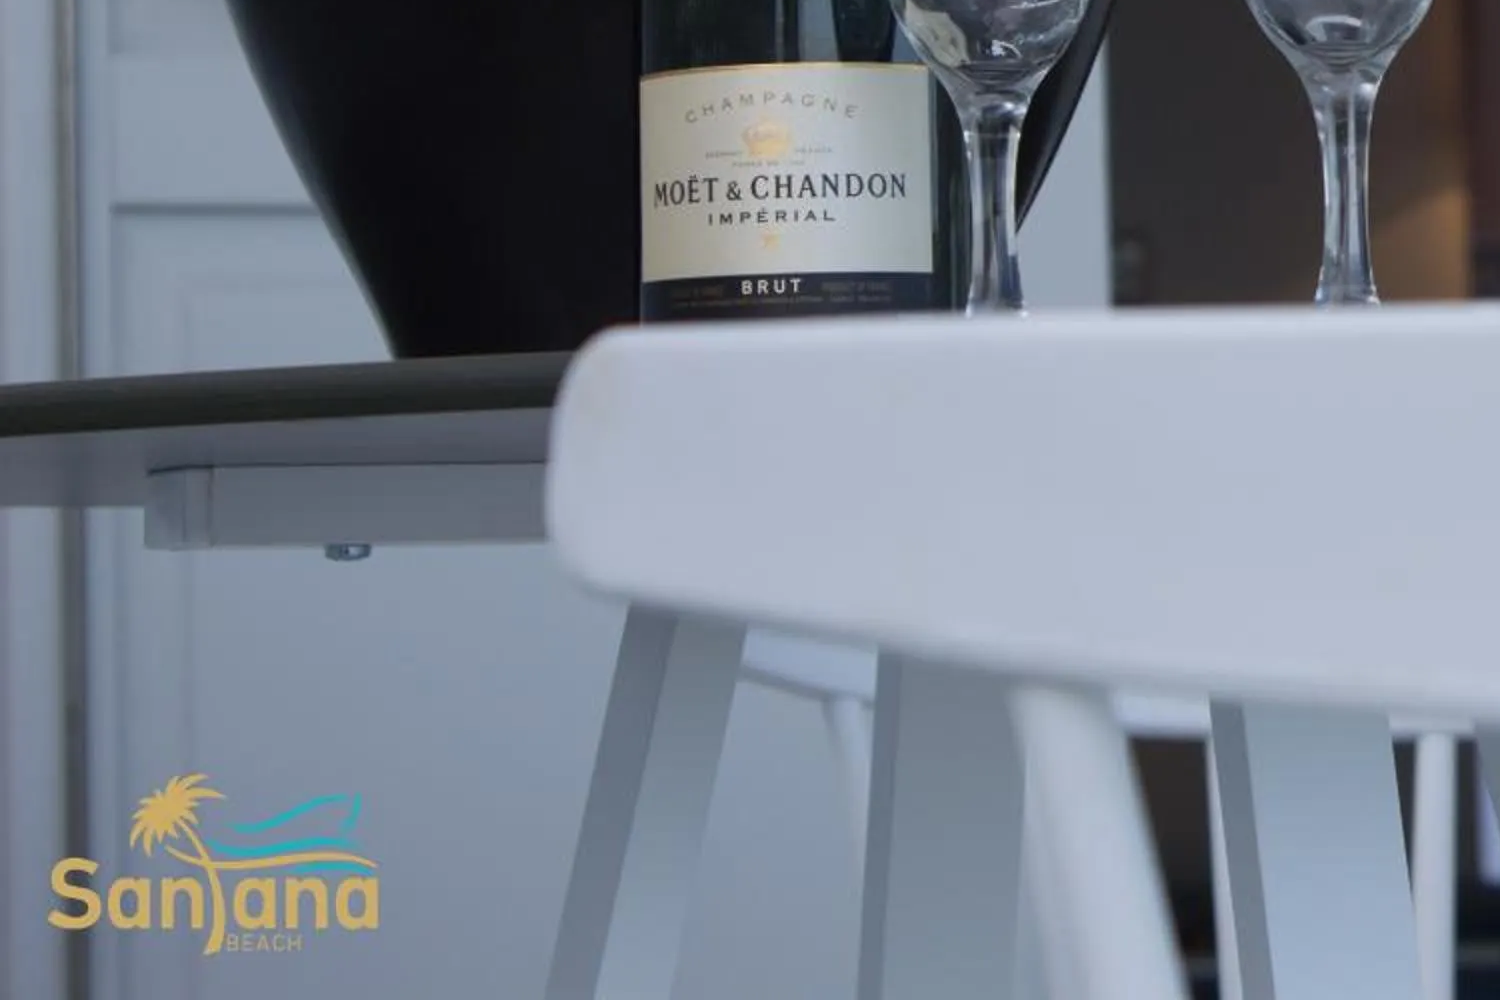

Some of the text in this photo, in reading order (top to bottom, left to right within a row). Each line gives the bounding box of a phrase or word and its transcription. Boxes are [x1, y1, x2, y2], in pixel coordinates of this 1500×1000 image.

[685, 91, 860, 123] CHAMPAGNE
[654, 173, 907, 208] MOËT & CHANDON
[708, 208, 836, 226] IMPÉRIAL
[741, 278, 802, 295] BRUT
